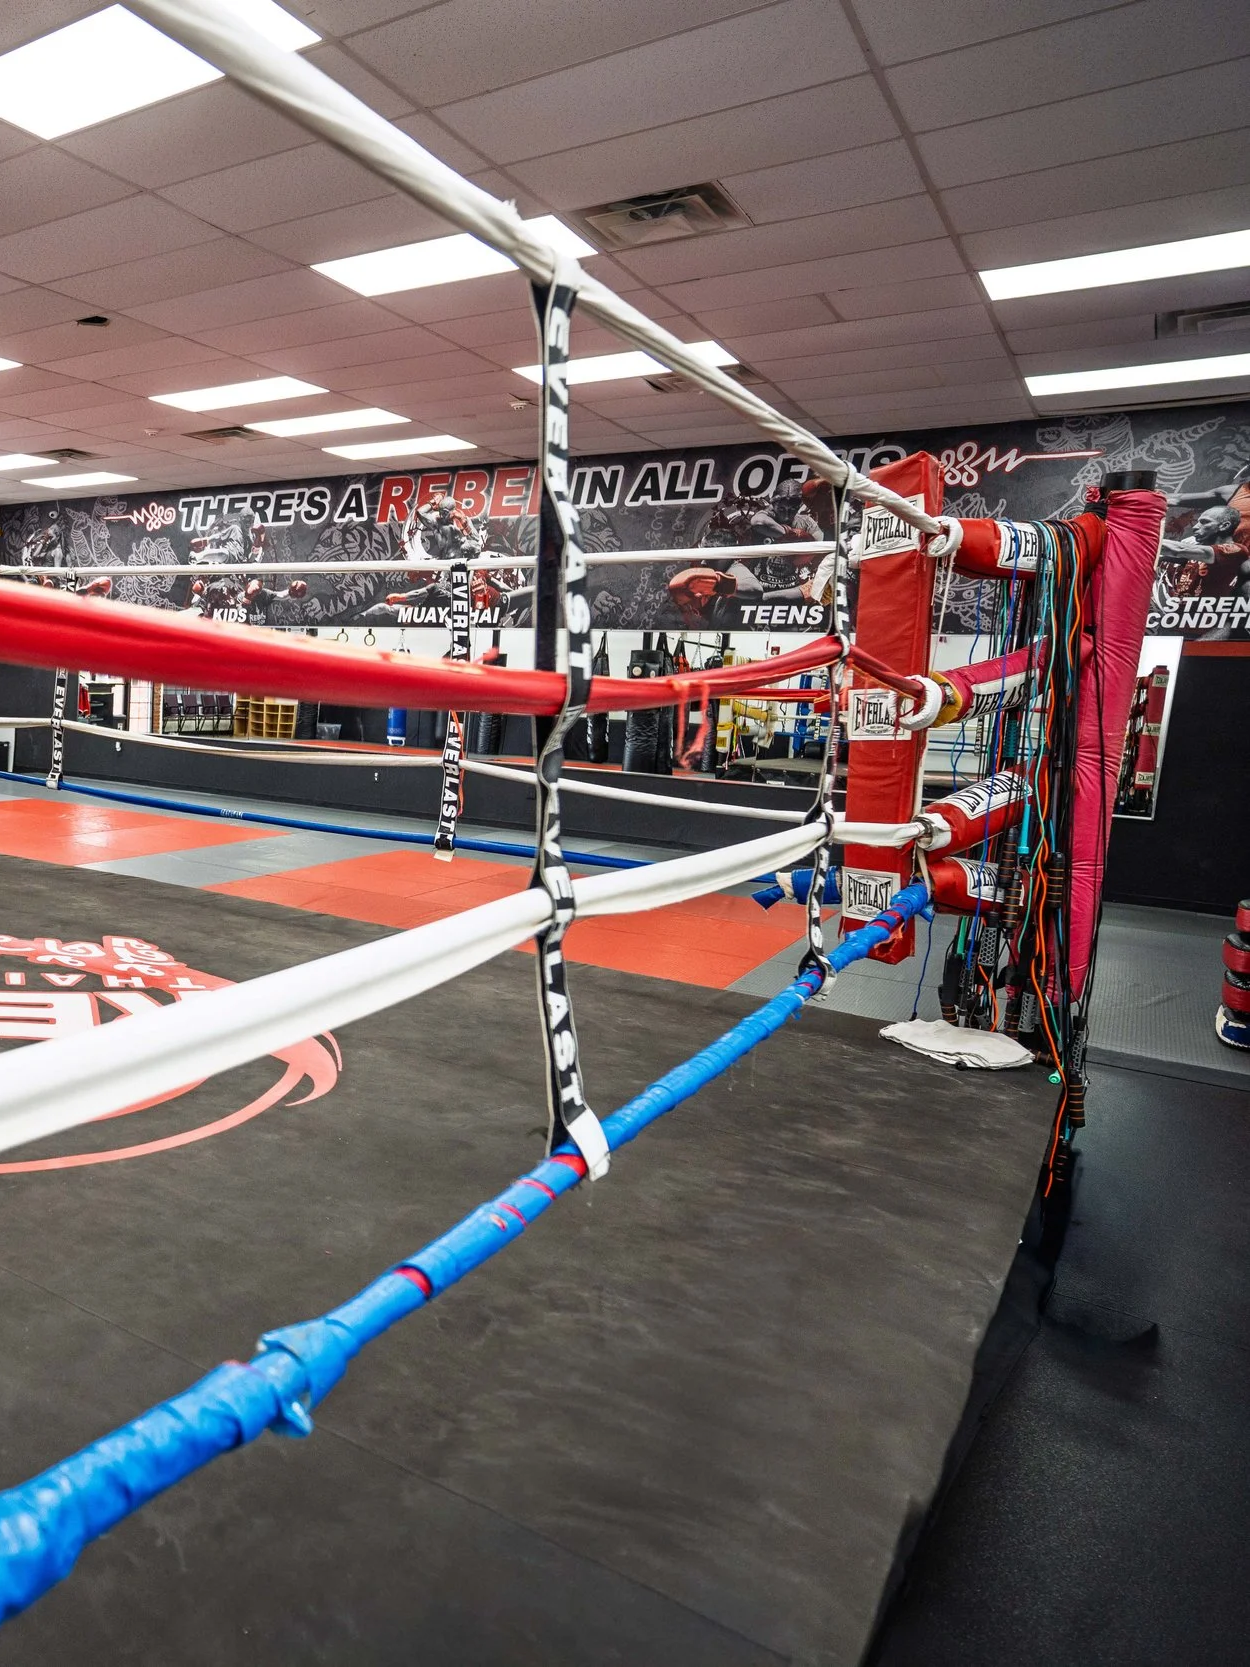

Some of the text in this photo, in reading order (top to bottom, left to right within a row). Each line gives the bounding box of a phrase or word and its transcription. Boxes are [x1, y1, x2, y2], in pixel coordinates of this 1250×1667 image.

[179, 487, 330, 531] THERE'S
[333, 484, 368, 522] A
[570, 465, 624, 509] IN
[625, 459, 723, 508] ALL
[547, 307, 591, 680] EVERLAST
[213, 608, 248, 623] KIDS
[398, 607, 500, 624] MUAY HAI
[452, 571, 467, 663] EVERLA
[740, 605, 824, 625] TEENS
[52, 685, 65, 773] EVERLAST
[442, 720, 462, 833] EVERLAST
[848, 874, 892, 911] EVERLAST
[4, 971, 206, 991] THAI
